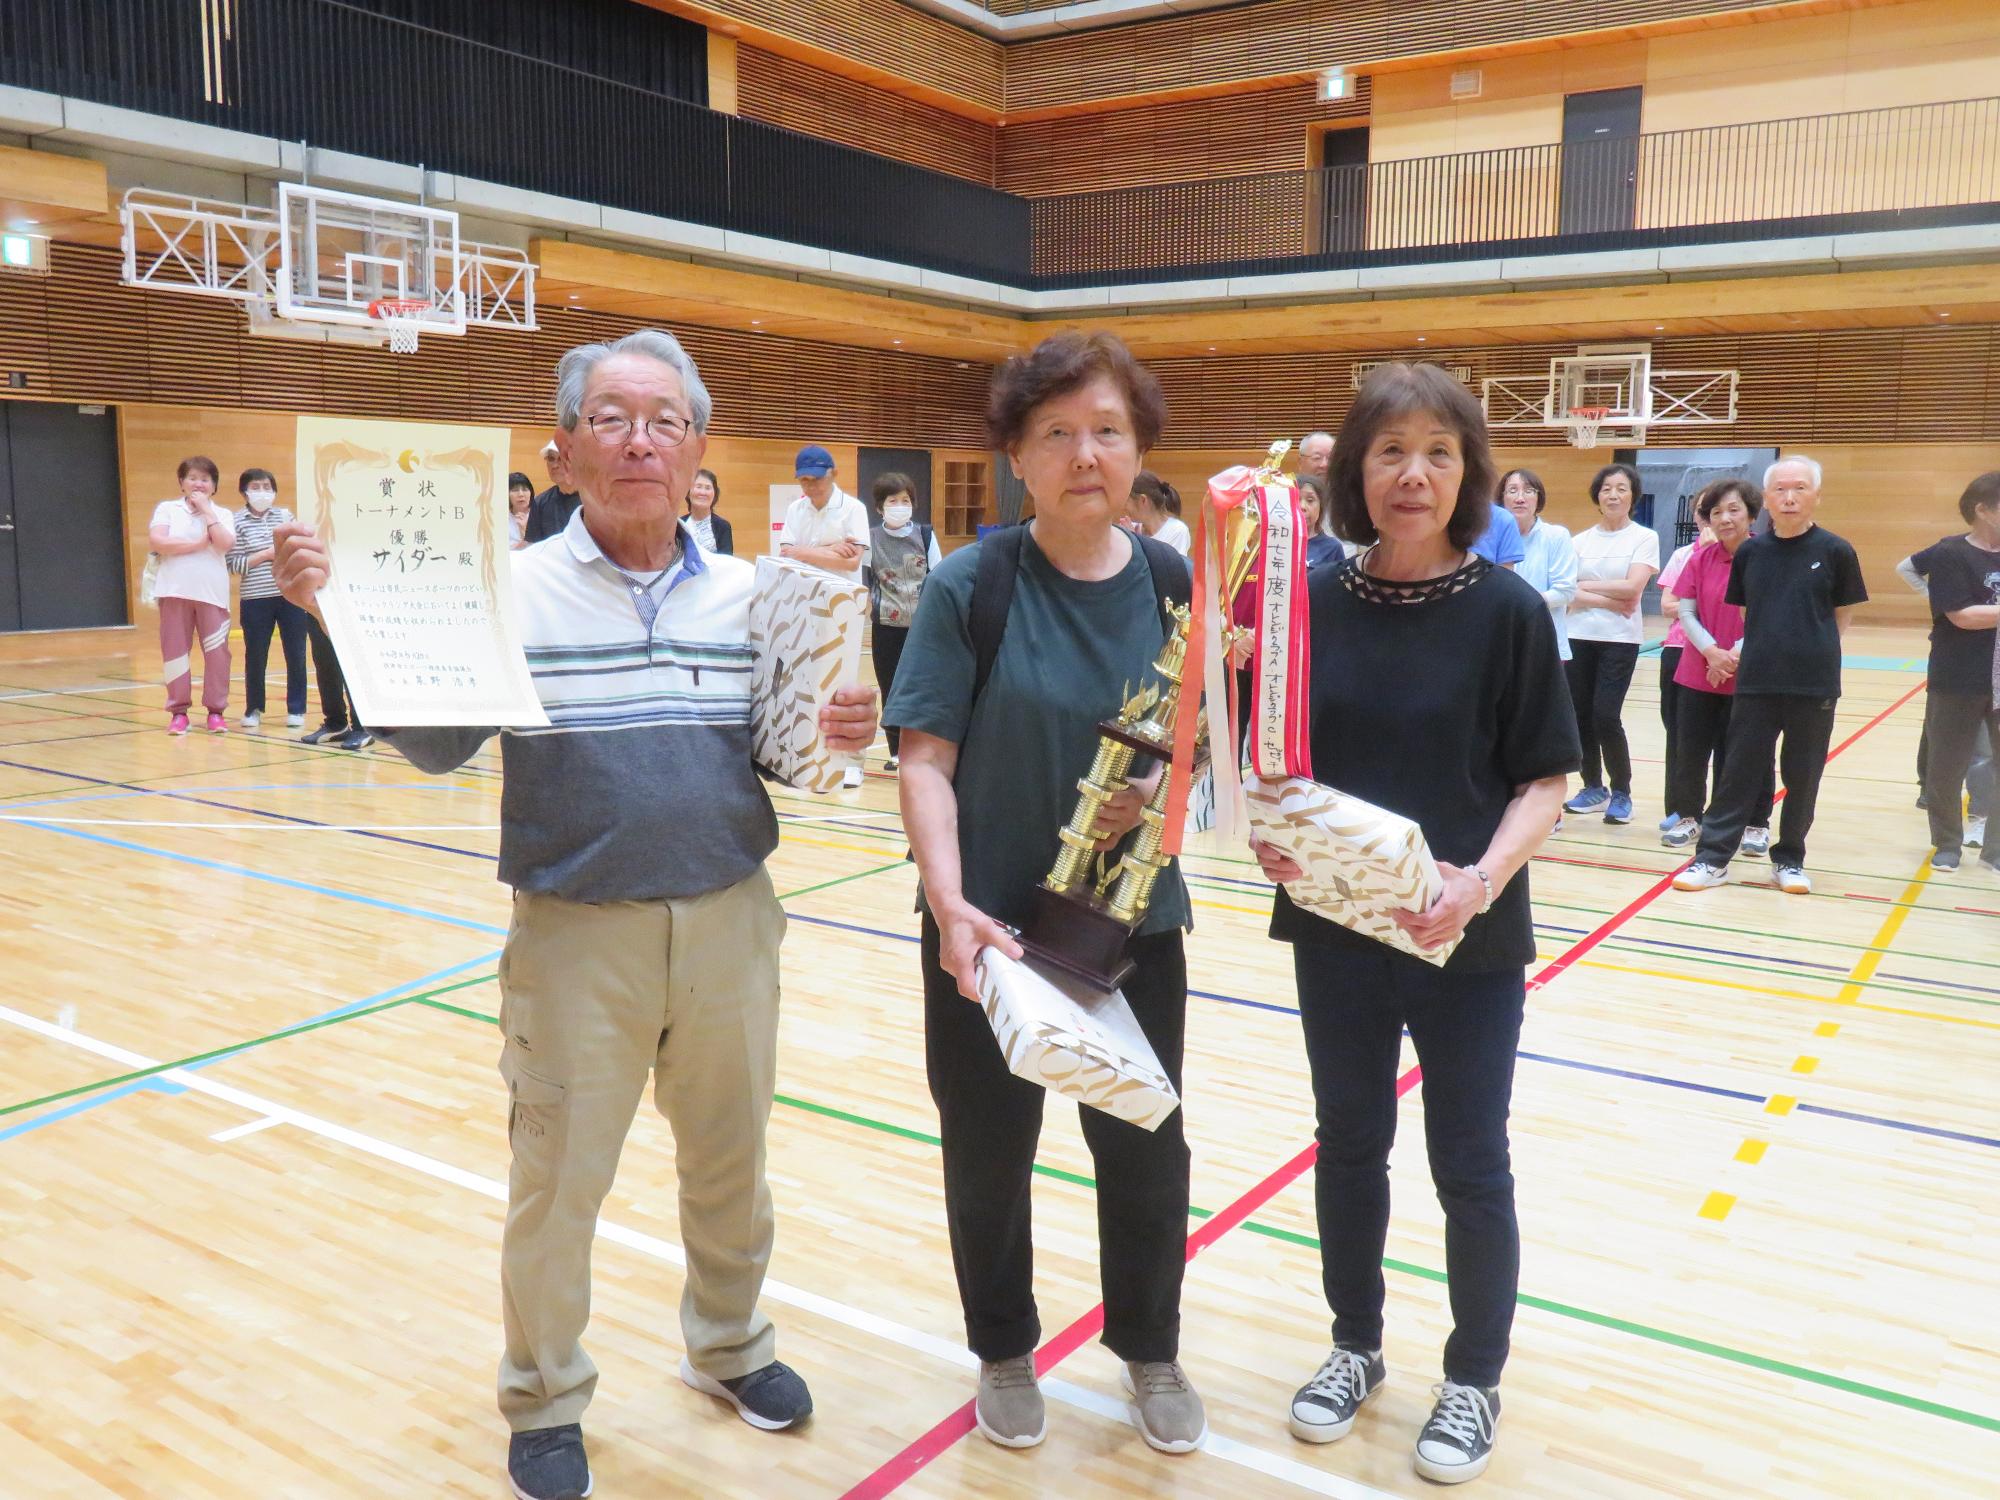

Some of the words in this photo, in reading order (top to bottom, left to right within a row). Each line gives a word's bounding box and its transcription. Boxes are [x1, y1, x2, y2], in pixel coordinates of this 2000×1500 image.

[355, 503, 465, 520] トーナメントB
[389, 528, 430, 546] 優勝
[372, 546, 448, 573] サイダー
[458, 551, 475, 567] 殿
